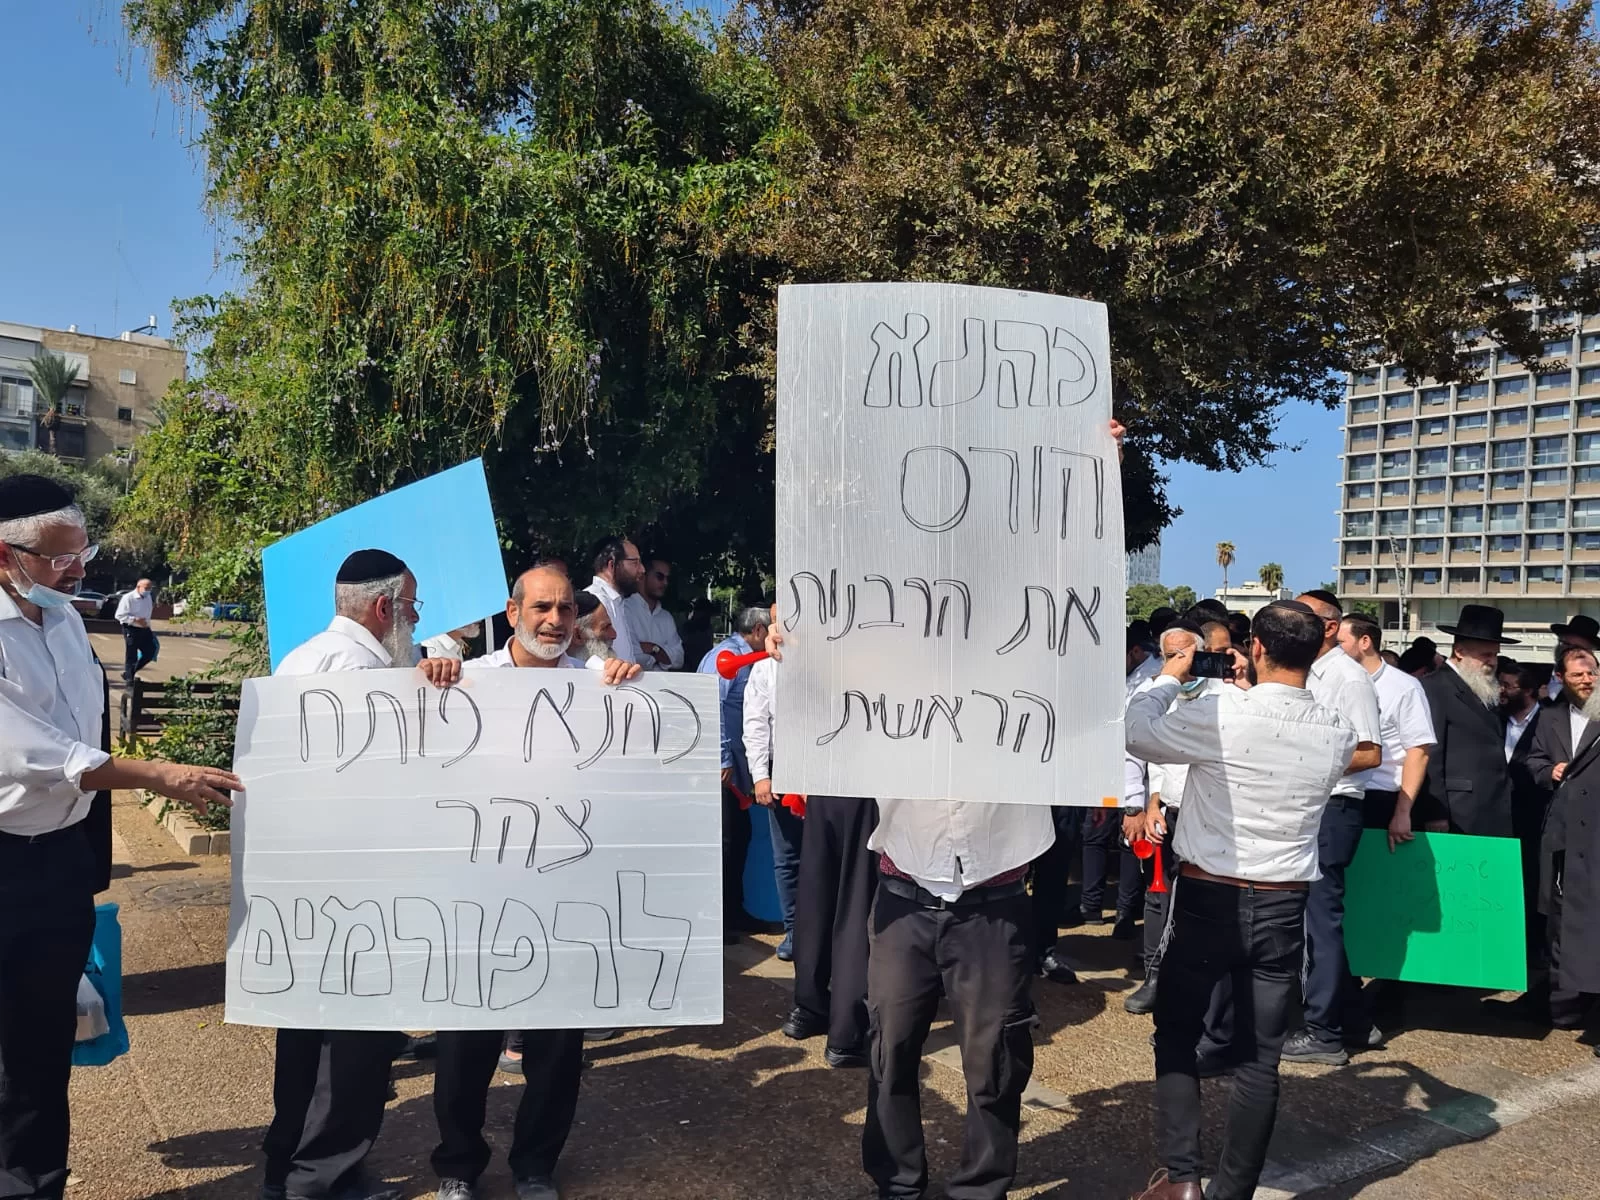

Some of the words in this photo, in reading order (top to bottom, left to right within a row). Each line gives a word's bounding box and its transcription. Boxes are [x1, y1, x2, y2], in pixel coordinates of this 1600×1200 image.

[864, 312, 1098, 409] כהנא
[900, 445, 1104, 540] הורס
[783, 568, 972, 641] הרבנות
[996, 585, 1101, 656] את
[300, 686, 483, 773] פותח
[523, 681, 702, 771] כהנא
[816, 689, 1056, 763] הראשית
[240, 870, 692, 1010] לרפורמים
